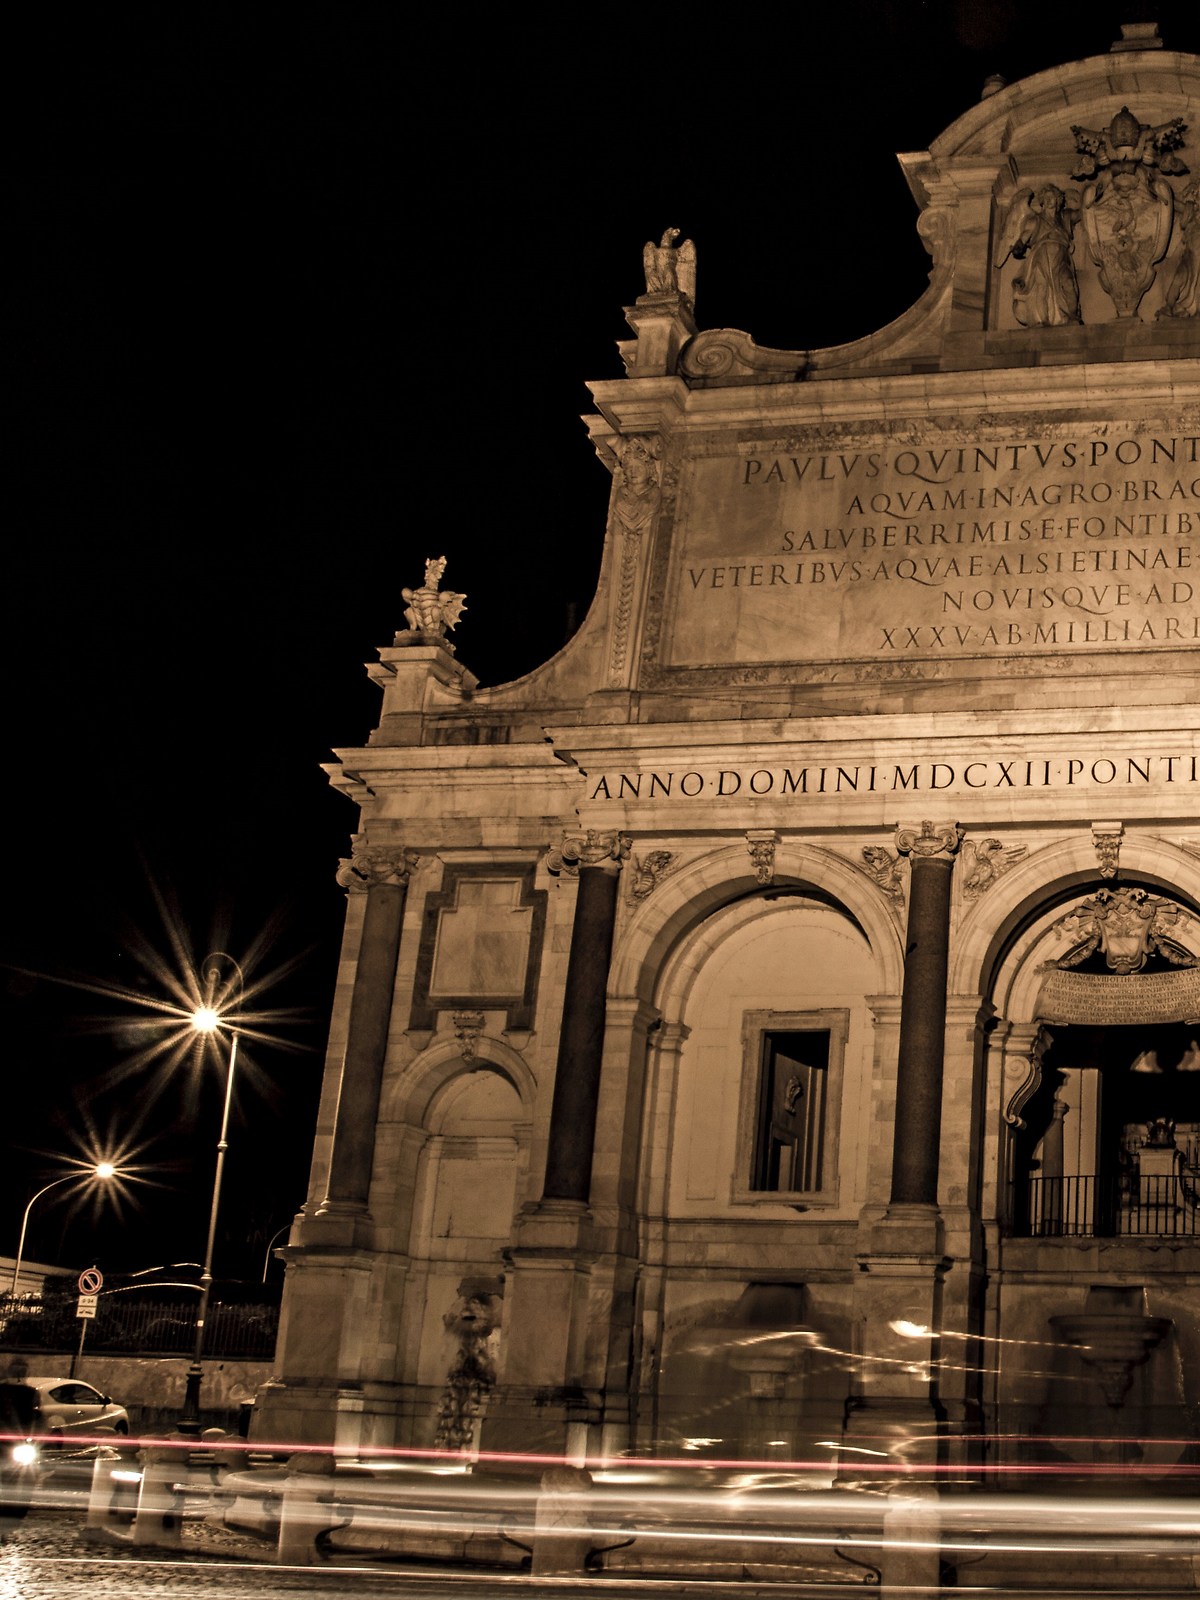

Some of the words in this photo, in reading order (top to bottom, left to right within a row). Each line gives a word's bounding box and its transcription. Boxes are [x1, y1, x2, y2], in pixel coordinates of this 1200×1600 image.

[742, 453, 881, 485] PAVLVS
[894, 442, 1077, 485] QVINTVS
[846, 488, 967, 520] AQVAM
[976, 486, 1016, 510] IN
[1018, 481, 1113, 507] AGRO
[781, 519, 1032, 552] SALVBERRIMIS
[1040, 519, 1056, 541] E
[687, 559, 863, 590] VETERIBVS
[873, 555, 984, 587] AQVAE
[994, 544, 1191, 577] ALSIETINAE
[942, 583, 1131, 616] NOVISQVE
[877, 624, 973, 650] XXXV
[980, 622, 1022, 648] AB
[590, 772, 704, 800] ANNO
[716, 765, 877, 797] DOMINI
[890, 760, 1052, 791] MDCXII
